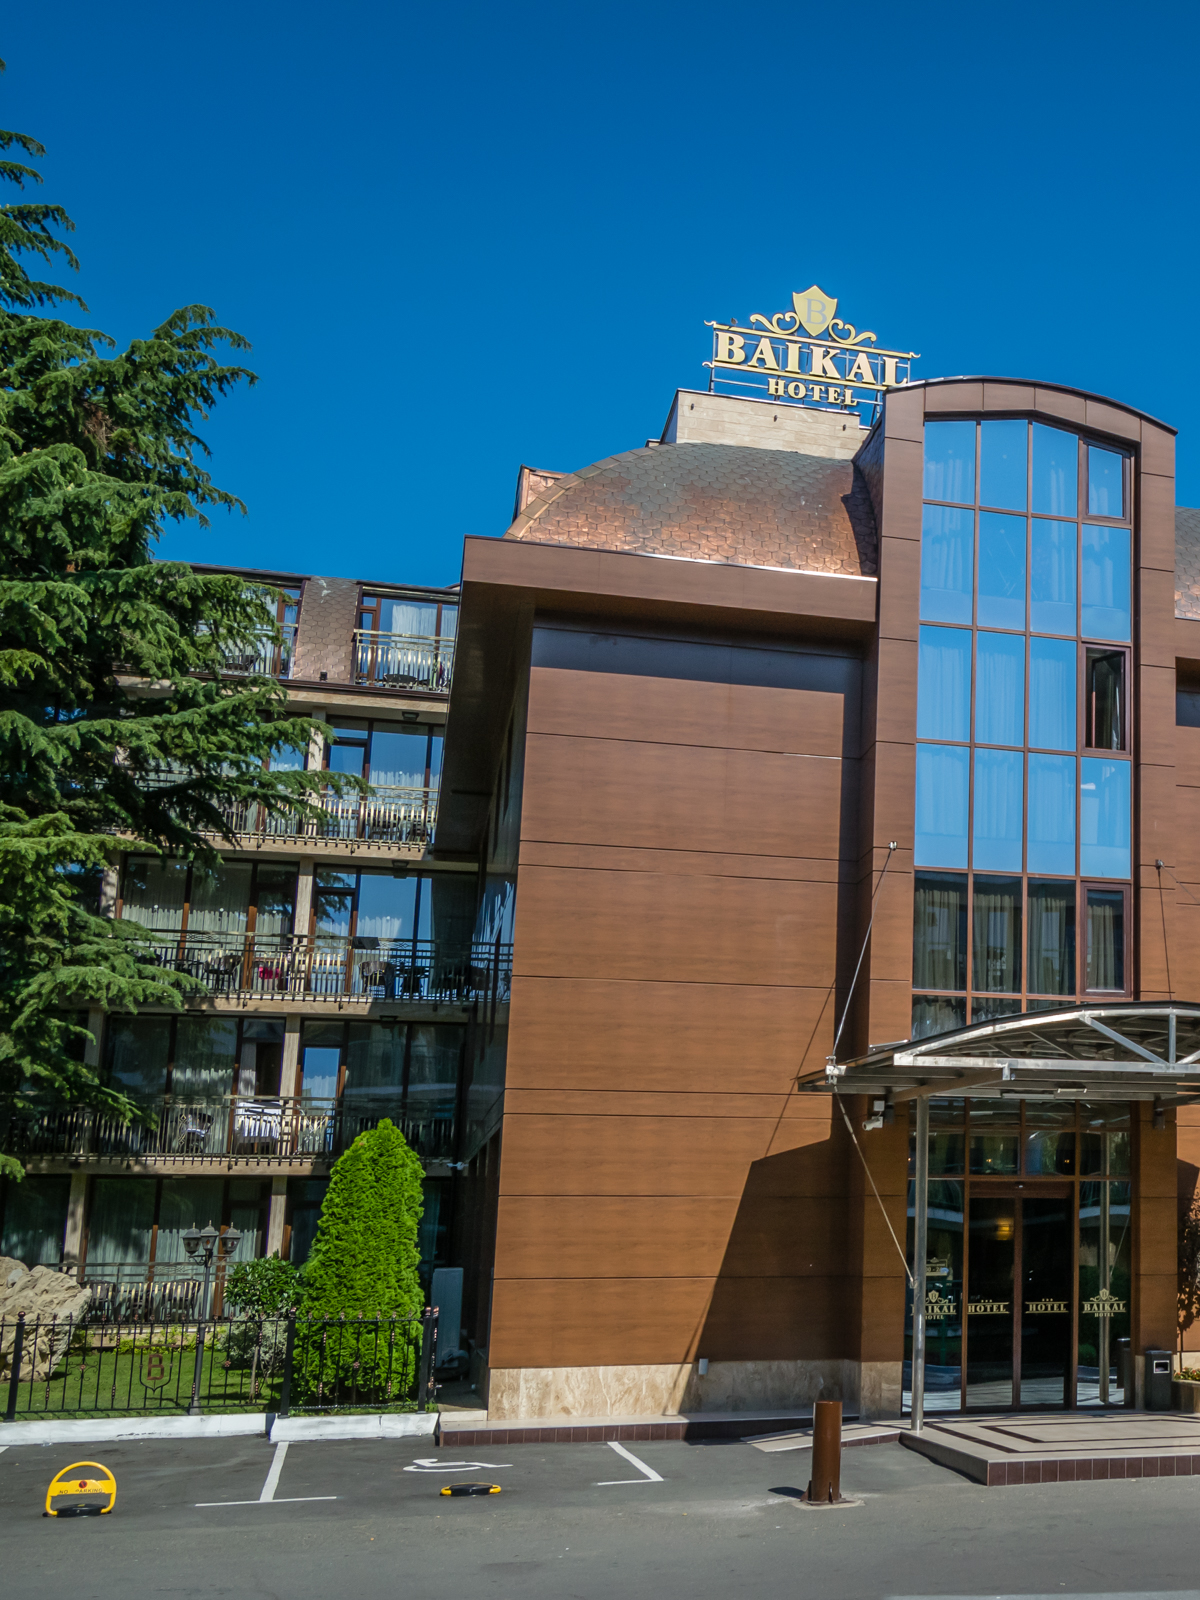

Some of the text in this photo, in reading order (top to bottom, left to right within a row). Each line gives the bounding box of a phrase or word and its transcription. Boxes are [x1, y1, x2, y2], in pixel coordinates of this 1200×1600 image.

[804, 298, 827, 325] B
[714, 331, 908, 386] BAIKAL
[767, 378, 858, 406] HOTEL
[968, 1304, 1006, 1312] HOTEL
[1028, 1303, 1066, 1312] HOTEL
[1084, 1303, 1125, 1311] BAIKAL
